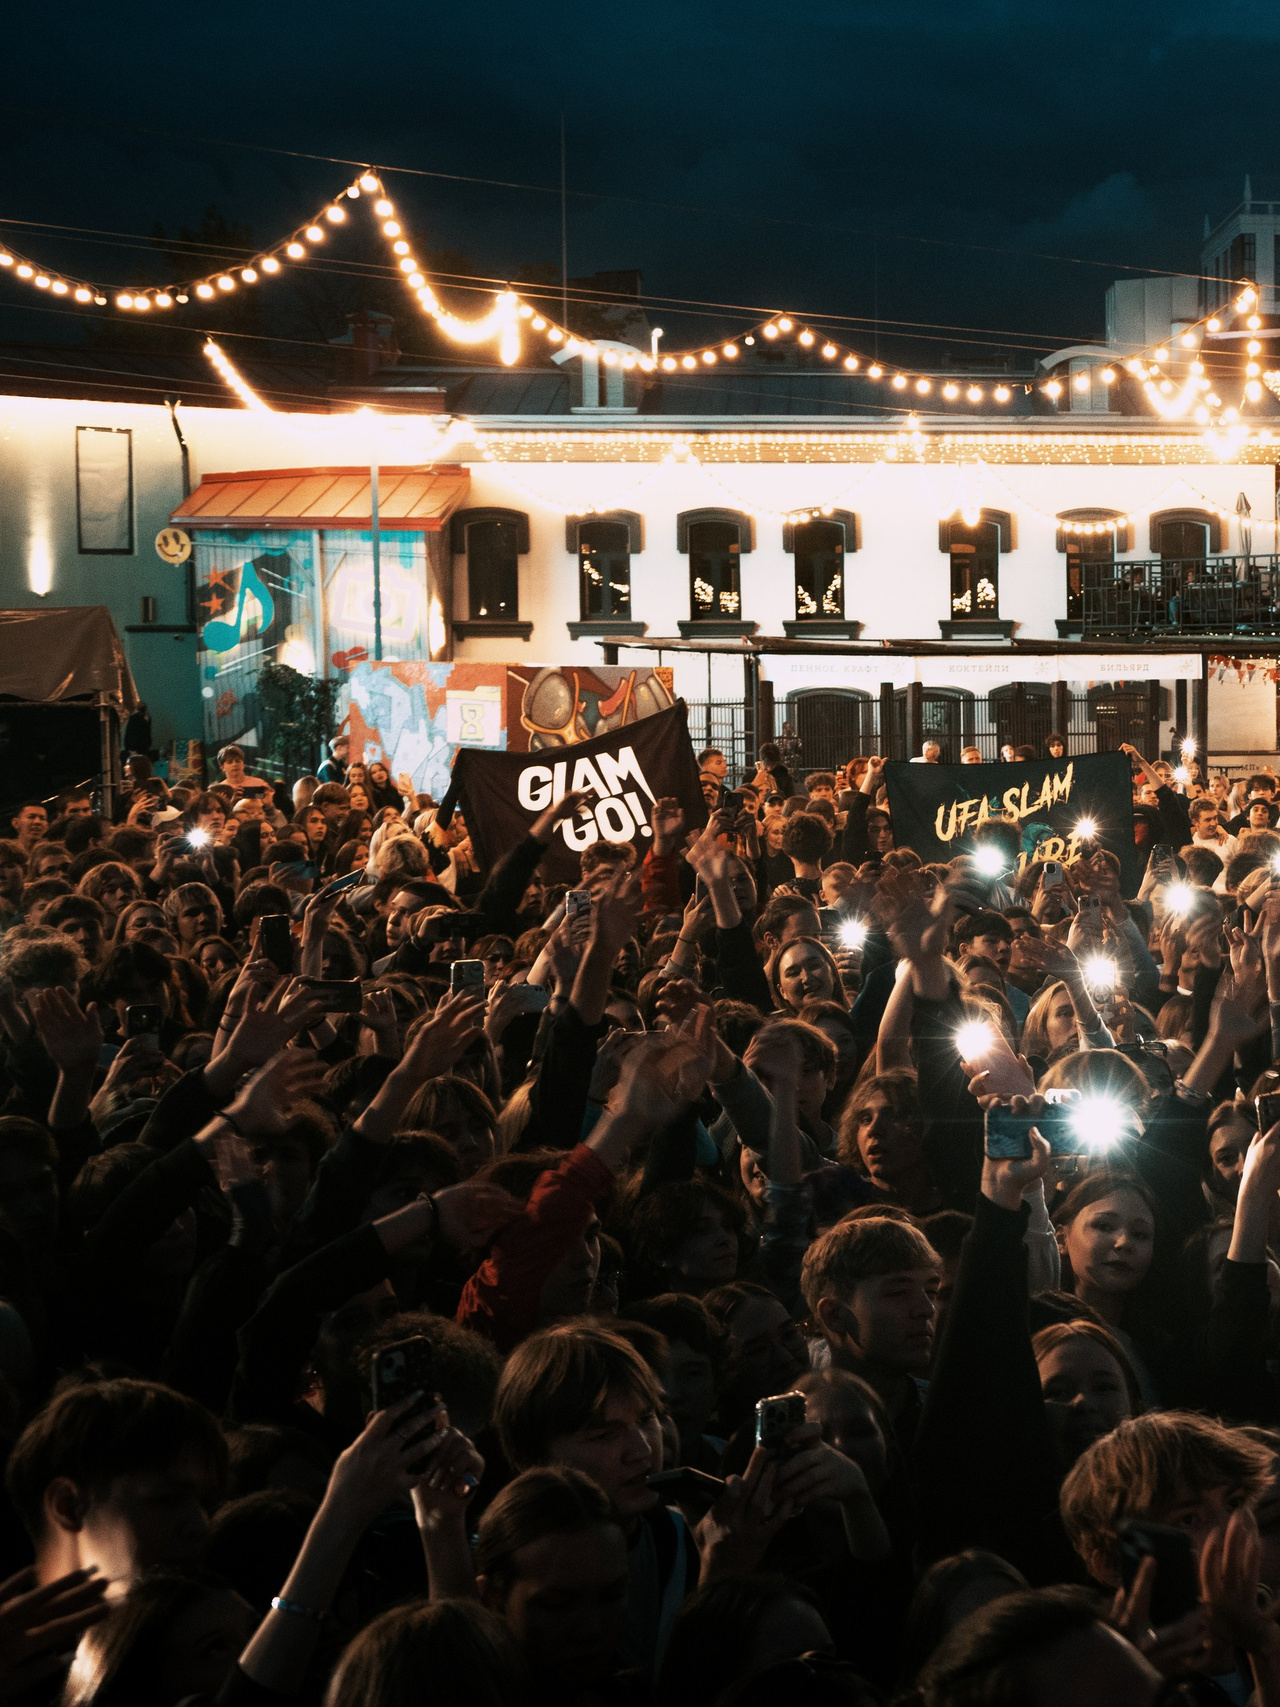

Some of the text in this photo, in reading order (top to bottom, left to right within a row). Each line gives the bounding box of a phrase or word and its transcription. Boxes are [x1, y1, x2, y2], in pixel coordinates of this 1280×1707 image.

[844, 665, 879, 673] КРАФТ
[948, 663, 1009, 673] КОКТЕЙЛИ
[1100, 663, 1150, 672] БИЛЬЯРД
[935, 761, 1074, 842] UFA SLAM
[561, 792, 653, 852] GO!
